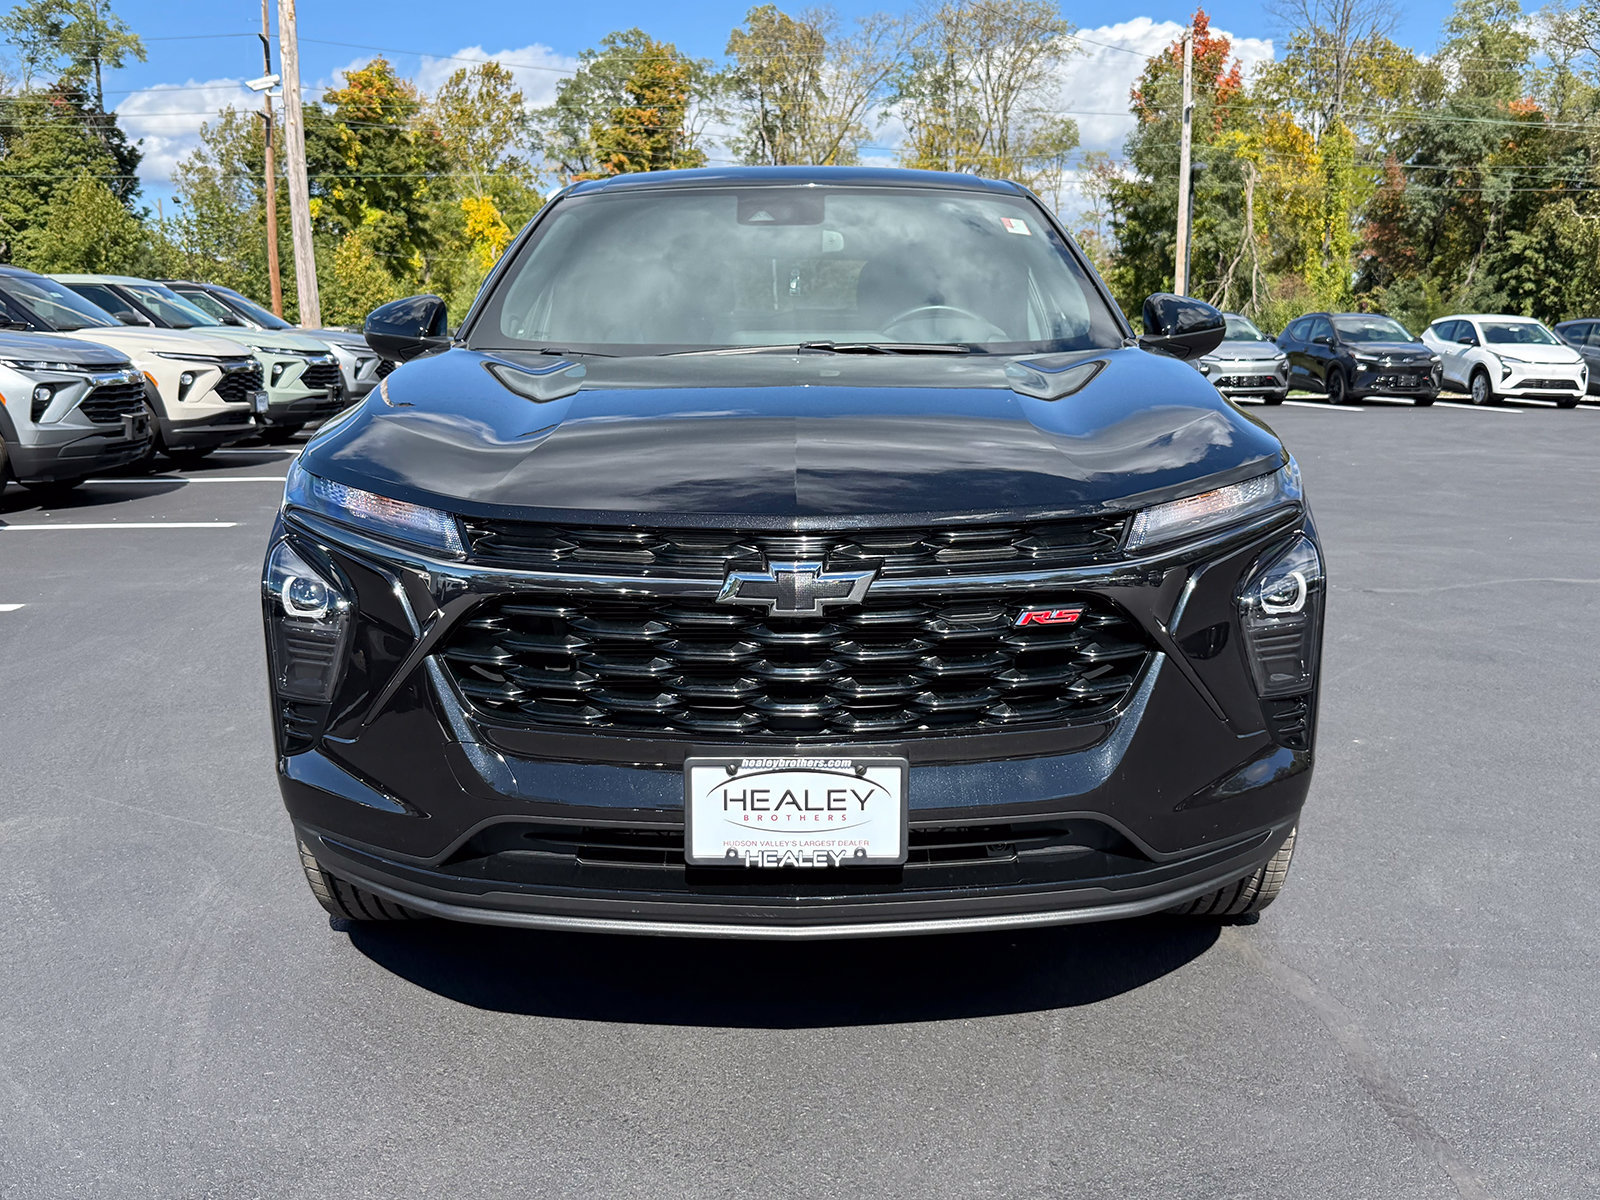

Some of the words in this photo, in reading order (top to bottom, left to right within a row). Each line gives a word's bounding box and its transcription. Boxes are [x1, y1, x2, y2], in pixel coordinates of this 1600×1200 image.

[1015, 608, 1083, 626] RS
[741, 758, 852, 770] healeybrothers.com
[723, 788, 876, 811] HEALEY
[743, 814, 847, 822] BROTHERS
[723, 840, 758, 848] HUDSON
[760, 840, 798, 848] VALLEY'S
[799, 840, 836, 848] LARGEST
[837, 840, 870, 848] DEALER
[744, 849, 847, 868] HEALEY
